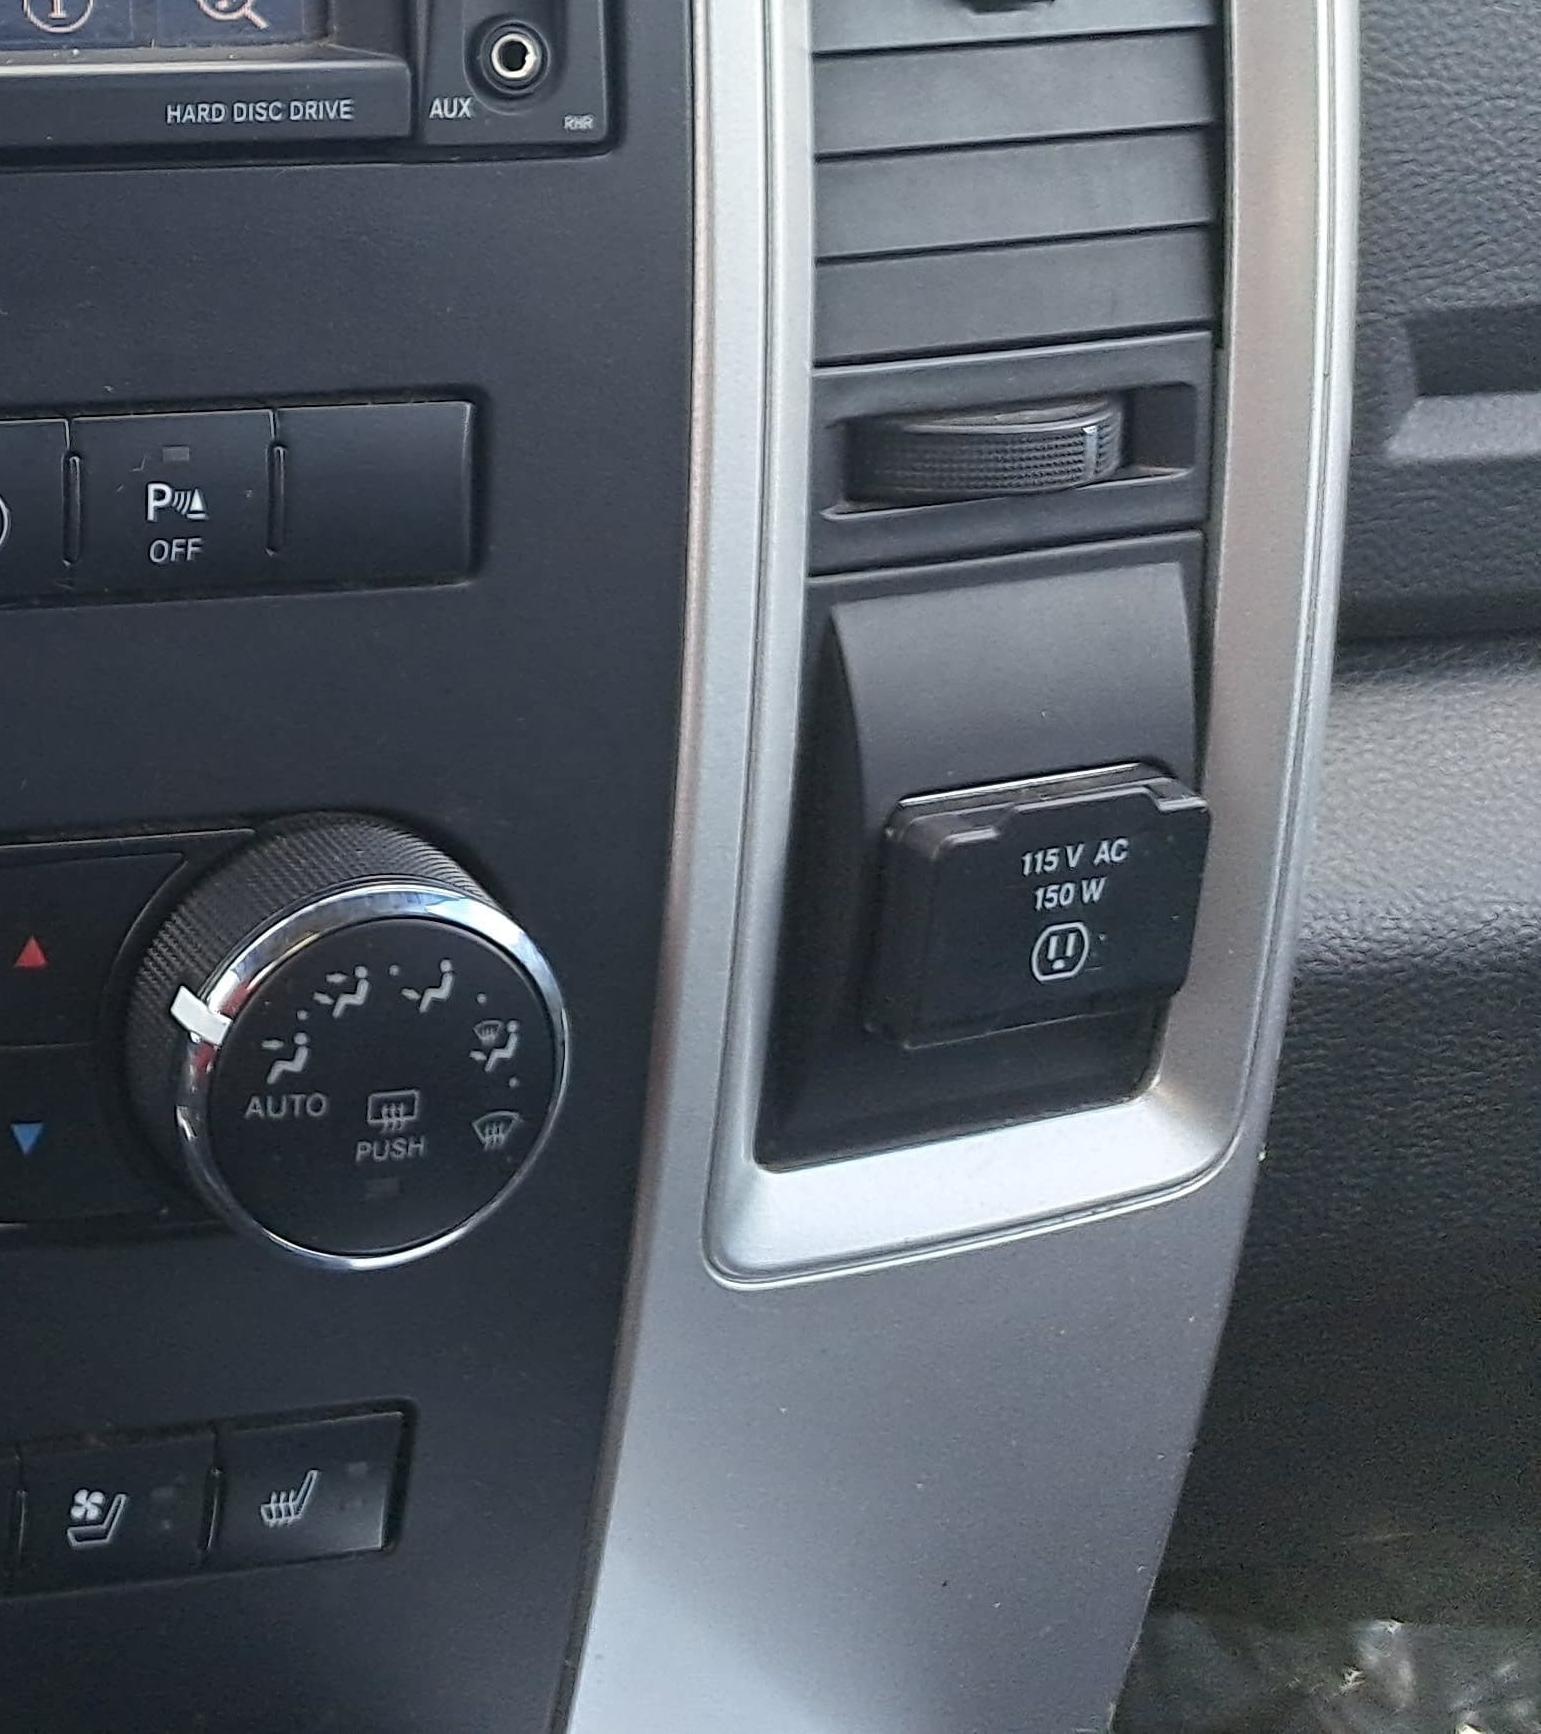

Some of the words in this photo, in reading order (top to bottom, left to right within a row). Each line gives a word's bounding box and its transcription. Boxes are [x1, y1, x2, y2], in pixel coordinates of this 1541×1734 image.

[166, 102, 227, 124] HARD
[233, 100, 284, 123] DISC
[289, 98, 356, 121] DRIVE
[429, 96, 474, 120] AUX
[148, 538, 203, 565] OFF
[1020, 847, 1060, 877] 115
[1065, 842, 1087, 868] V
[1093, 837, 1130, 866] AC
[1033, 883, 1075, 912] 150
[1078, 876, 1109, 905] W
[244, 1093, 330, 1120] AUTO
[355, 1137, 426, 1163] PUSH
